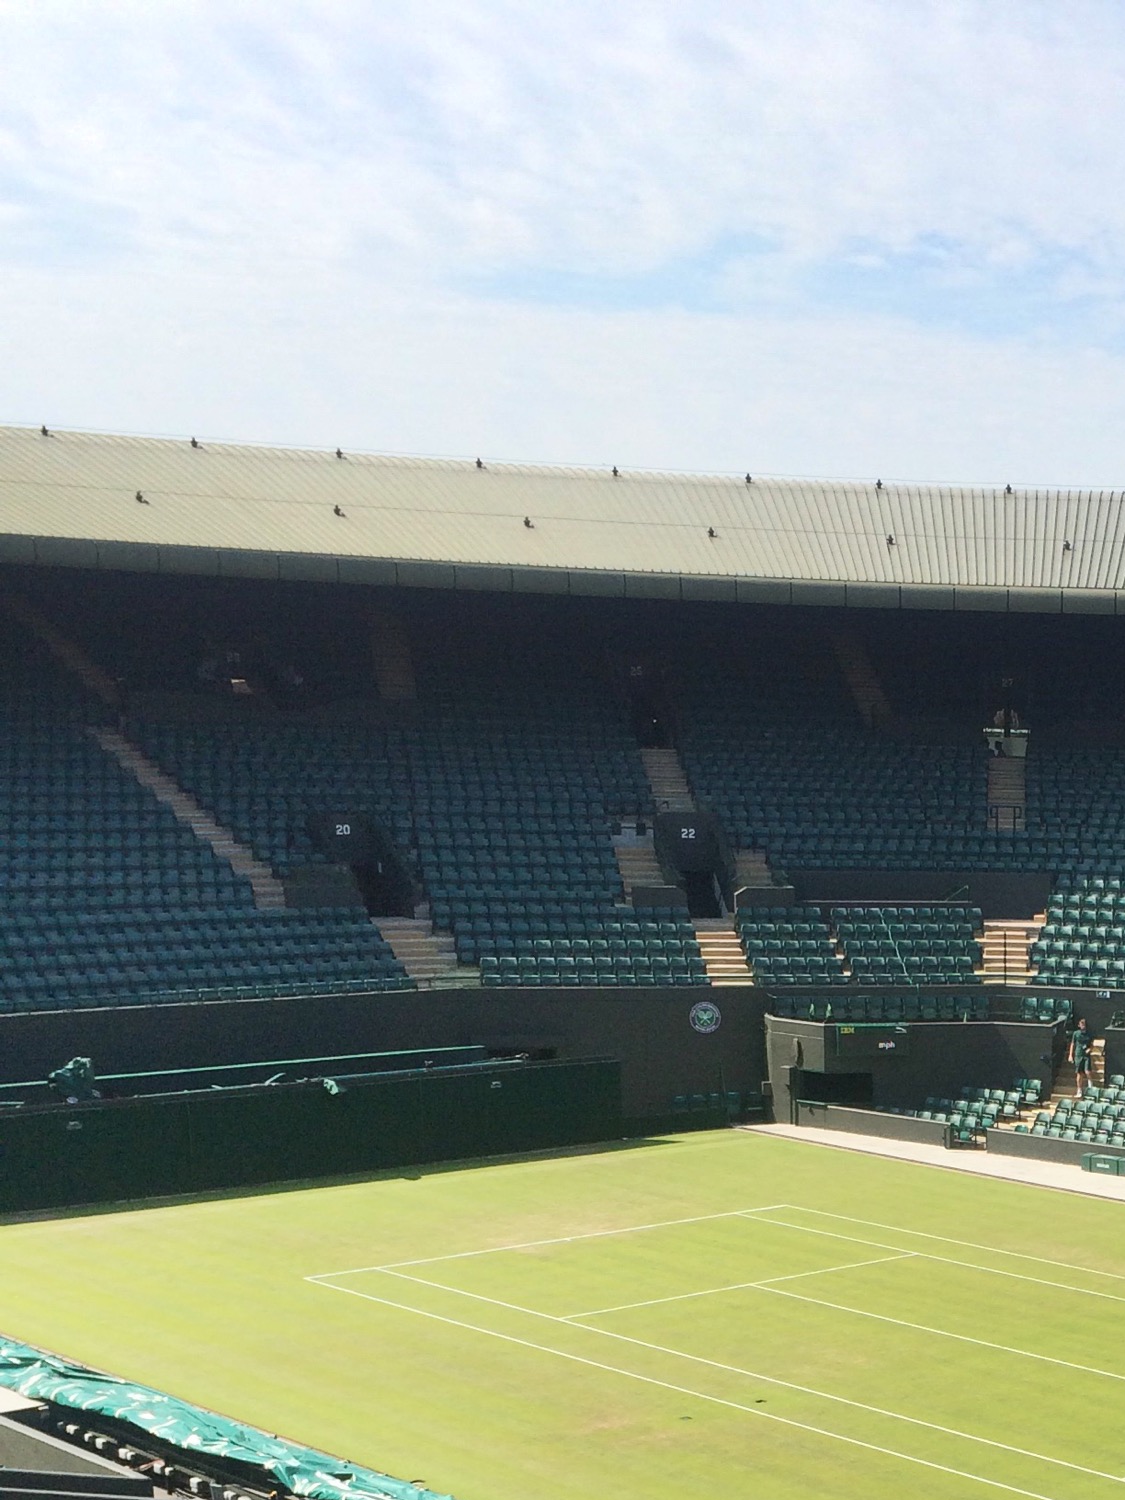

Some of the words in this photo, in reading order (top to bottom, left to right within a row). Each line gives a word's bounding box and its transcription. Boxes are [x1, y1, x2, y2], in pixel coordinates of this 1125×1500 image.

[335, 824, 351, 836] 20
[681, 828, 696, 839] 22
[878, 1040, 896, 1050] mph
